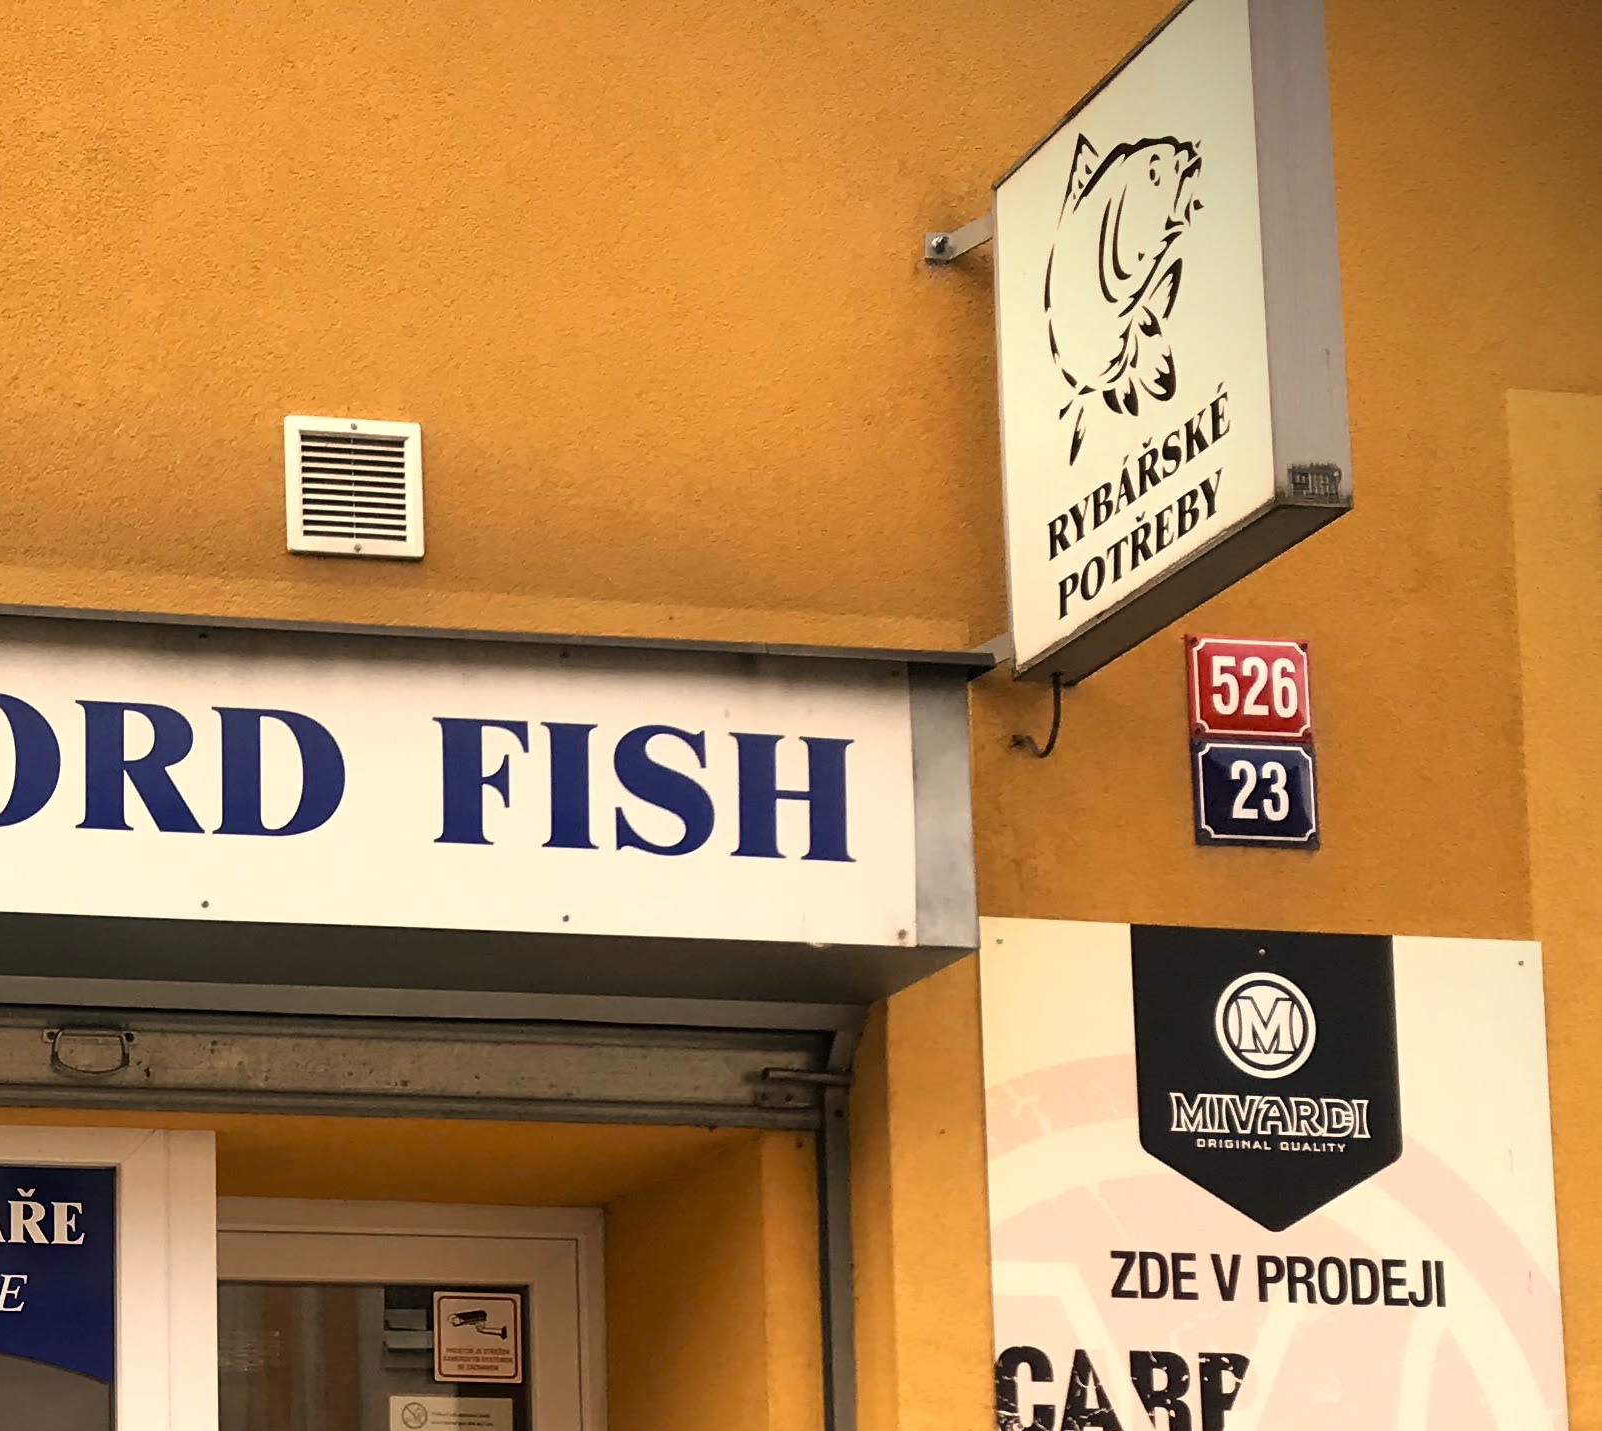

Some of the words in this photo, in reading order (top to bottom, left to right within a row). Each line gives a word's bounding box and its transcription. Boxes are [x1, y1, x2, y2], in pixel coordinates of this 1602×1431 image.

[1046, 381, 1232, 561] RYBÁŘSKÉ
[1057, 469, 1226, 621] POTŘEBY
[1211, 654, 1300, 720] 526
[432, 716, 857, 863] FISH
[1230, 759, 1290, 822] 23
[1169, 1091, 1371, 1139] MIVARDI
[1196, 1138, 1271, 1151] ORIGINAL
[1279, 1141, 1347, 1154] QUALITY
[1110, 1250, 1198, 1300] ZDE
[1210, 1253, 1241, 1301] V
[1257, 1256, 1446, 1308] PRODEJI
